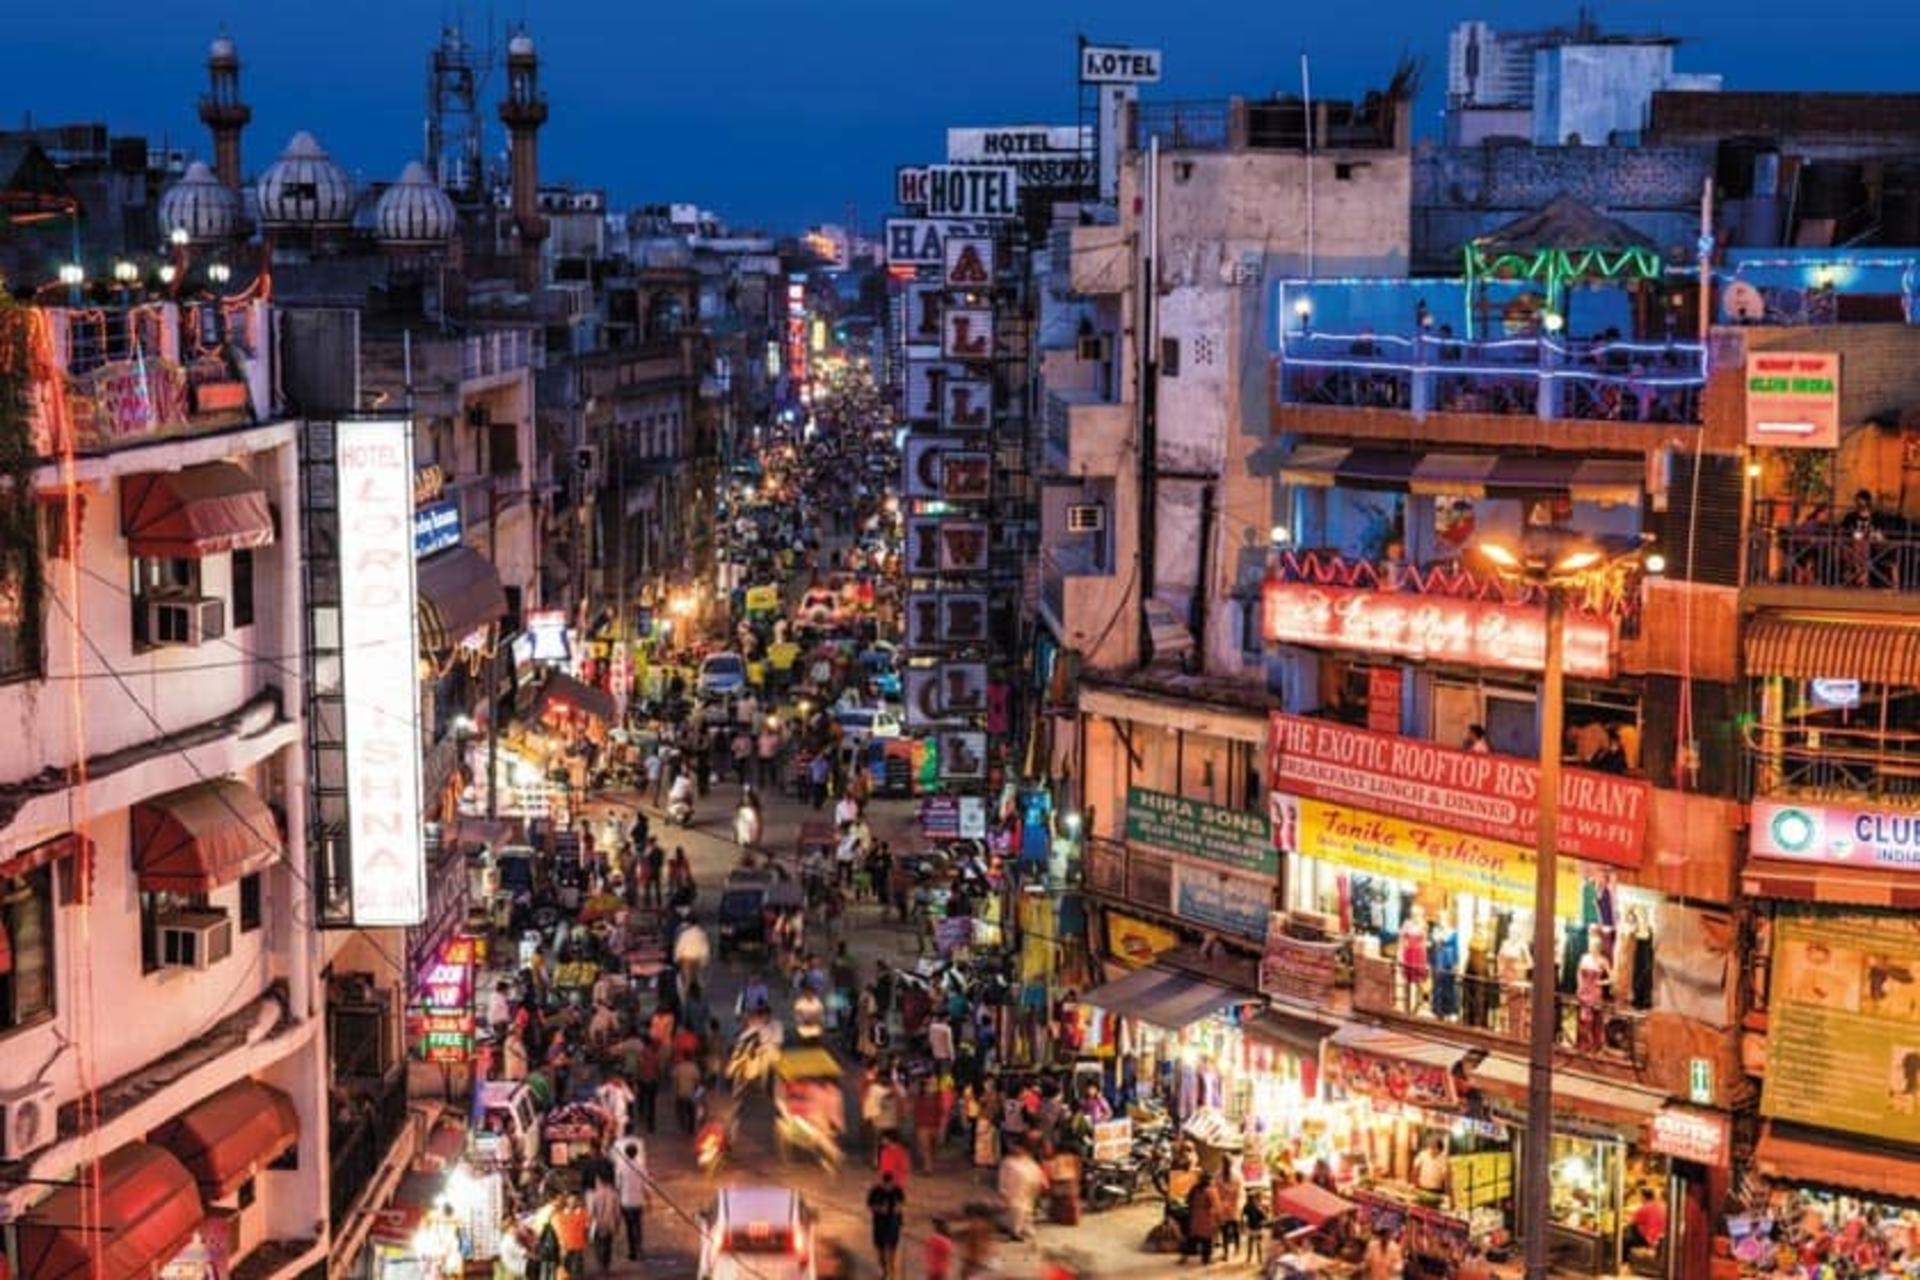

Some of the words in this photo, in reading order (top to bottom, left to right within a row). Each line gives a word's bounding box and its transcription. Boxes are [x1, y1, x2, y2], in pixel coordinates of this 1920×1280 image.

[985, 132, 1053, 153] HOTEL
[931, 169, 1013, 213] HOTEL
[1274, 716, 1313, 754] THE
[1316, 728, 1390, 769] EXOTIC
[1391, 742, 1492, 790] ROOFTOP
[1495, 761, 1644, 820] RESURANT
[1279, 756, 1369, 789] BREAKFAST
[1370, 776, 1425, 802] LUNCH
[1444, 795, 1511, 822] DINNER
[1202, 806, 1265, 835] SONS
[1409, 828, 1505, 871] Fashion
